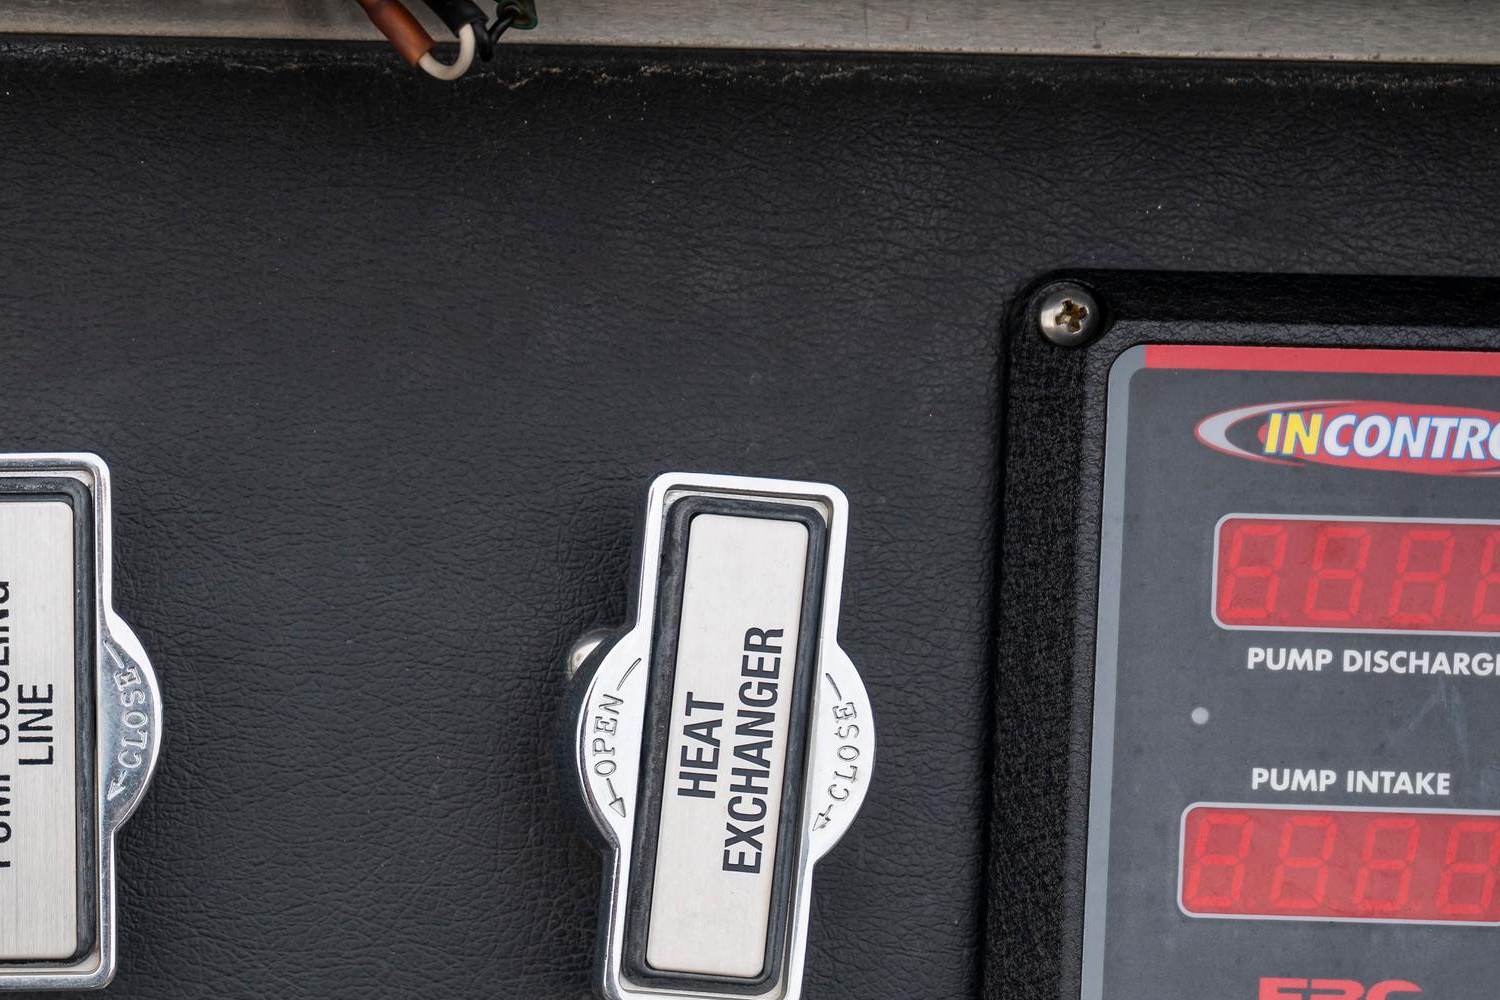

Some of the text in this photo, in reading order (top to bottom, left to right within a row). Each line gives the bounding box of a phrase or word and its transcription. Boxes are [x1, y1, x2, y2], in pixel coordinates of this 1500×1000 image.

[1247, 647, 1333, 672] PUMP
[17, 683, 53, 766] LINE
[114, 665, 149, 769] CLOSE
[593, 692, 625, 777] OPEN
[677, 691, 724, 799] HEAT
[722, 627, 784, 874] EXCHANGER
[827, 701, 860, 803] CLOSE
[1252, 767, 1450, 796] PUMP INTAKE
